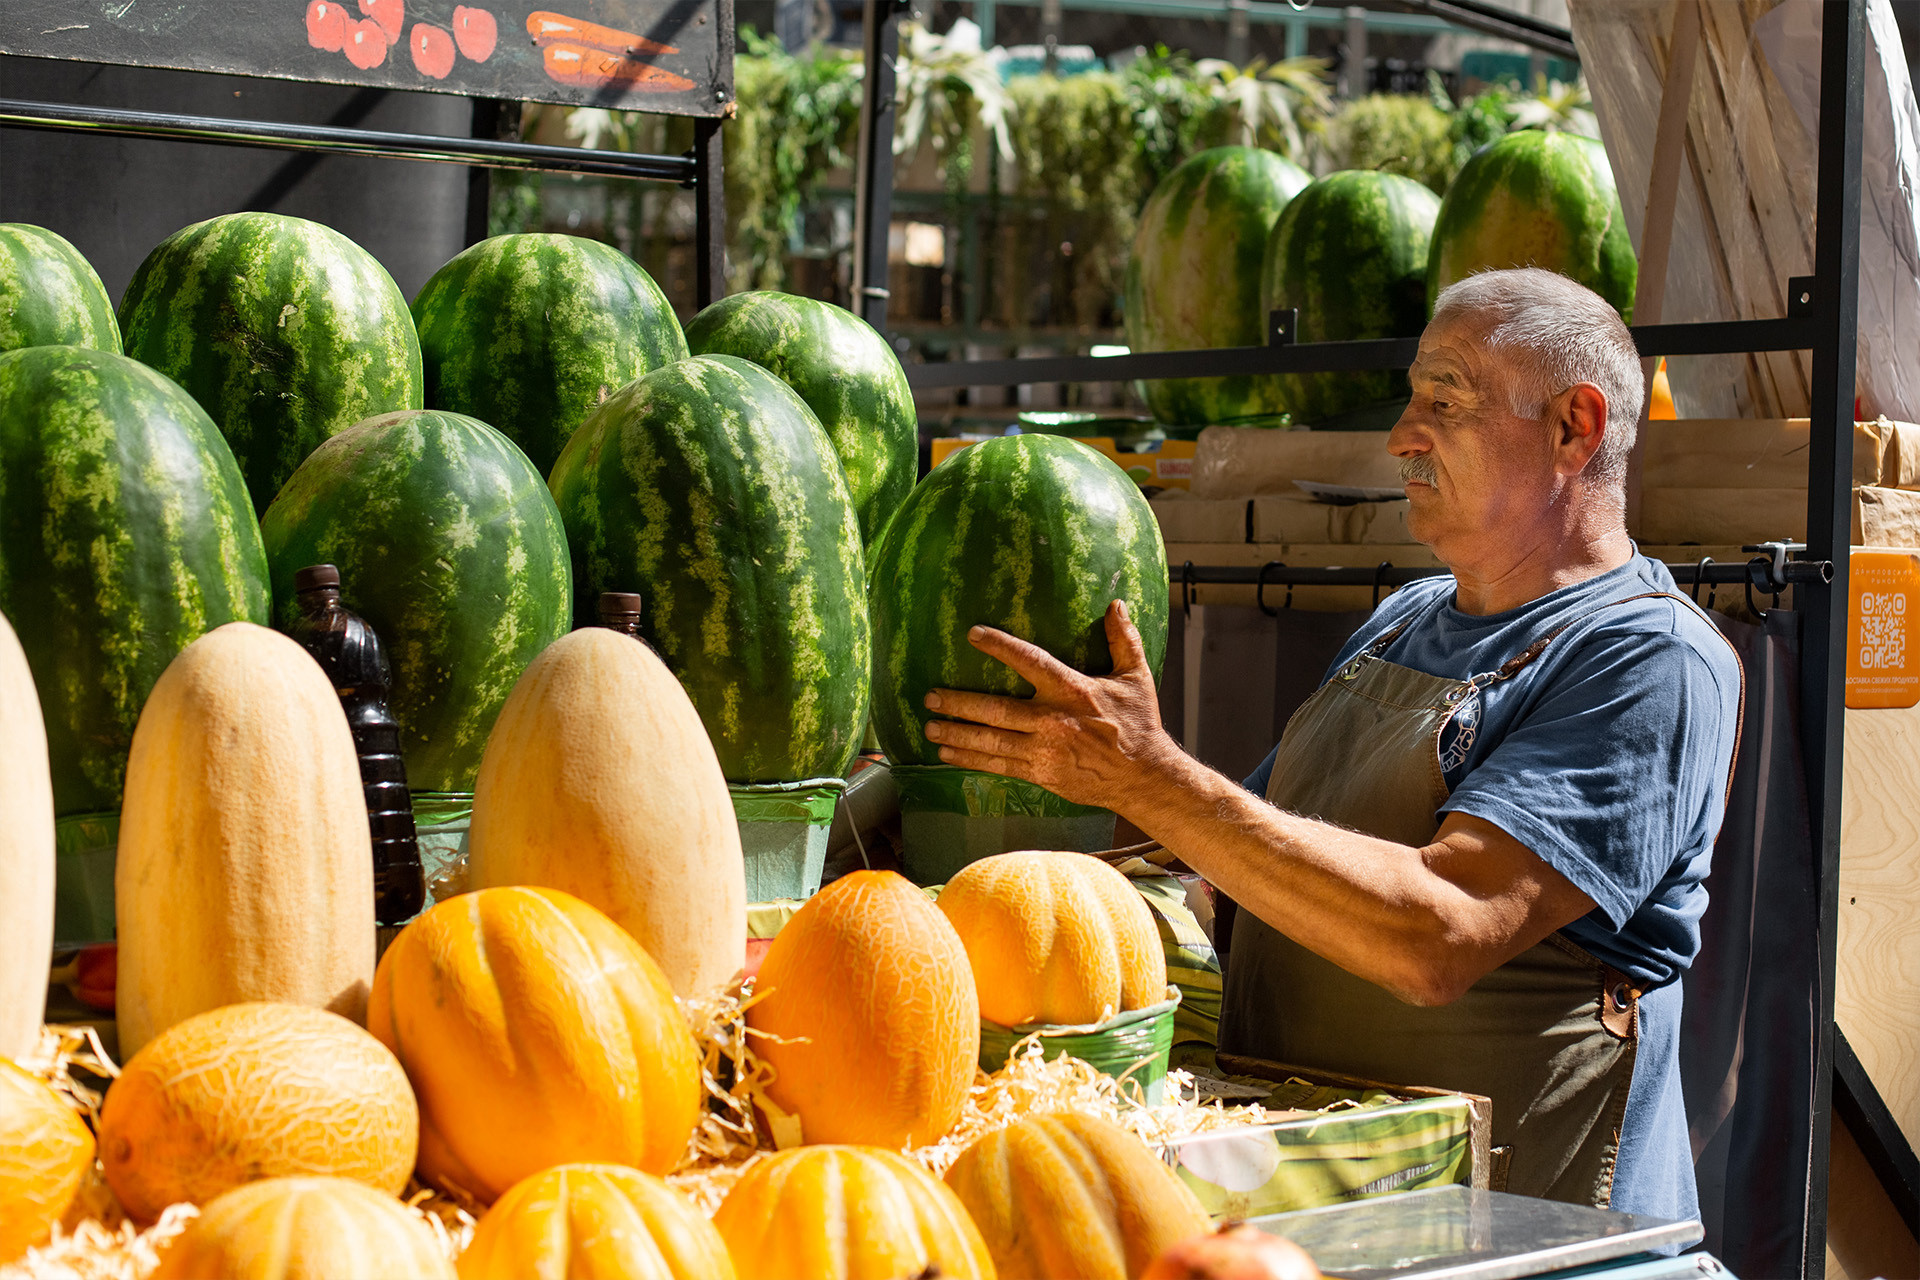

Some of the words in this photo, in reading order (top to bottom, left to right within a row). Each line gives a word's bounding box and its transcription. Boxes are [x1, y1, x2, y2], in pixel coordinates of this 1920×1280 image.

[1855, 568, 1912, 576] ДАНИЛОВСКИЙ
[1871, 577, 1896, 585] РЫНОК
[1845, 676, 1871, 684] ДОСТАВКА
[1871, 676, 1891, 684] СВЕЖИХ
[1892, 676, 1919, 685] ПРОДУКТОВ
